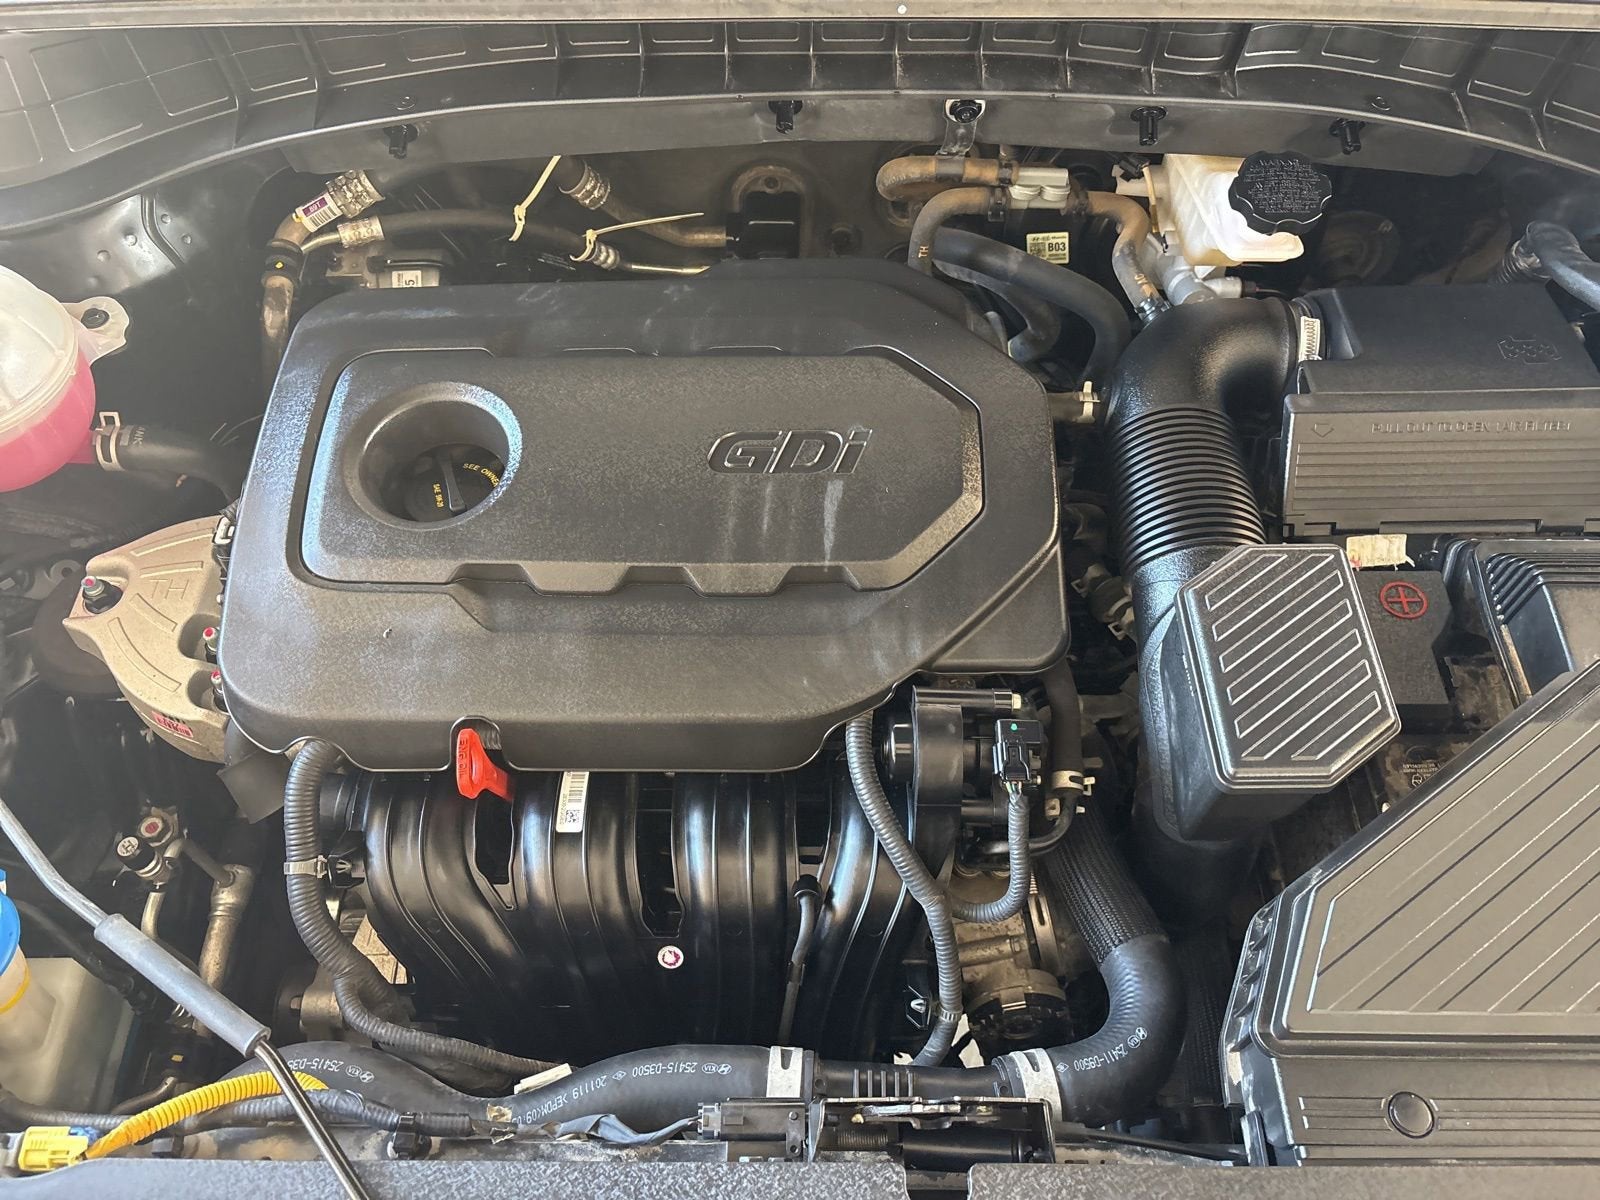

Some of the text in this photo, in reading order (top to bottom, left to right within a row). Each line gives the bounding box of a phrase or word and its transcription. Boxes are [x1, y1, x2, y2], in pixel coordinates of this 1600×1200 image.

[1047, 242, 1066, 252] B03
[1371, 422, 1403, 434] PULL
[1406, 422, 1434, 433] OUT
[1438, 421, 1453, 433] TO
[1455, 421, 1490, 433] OPEN
[706, 428, 873, 475] GDi
[463, 462, 480, 471] SEE
[433, 483, 442, 494] SAE
[149, 578, 189, 600] TH
[458, 738, 468, 778] ENG OIL
[1073, 1043, 1129, 1072] 25411-D9500
[632, 1061, 698, 1078] 25415-D3500
[702, 1063, 718, 1073] KIA
[572, 1074, 607, 1100] 201119
